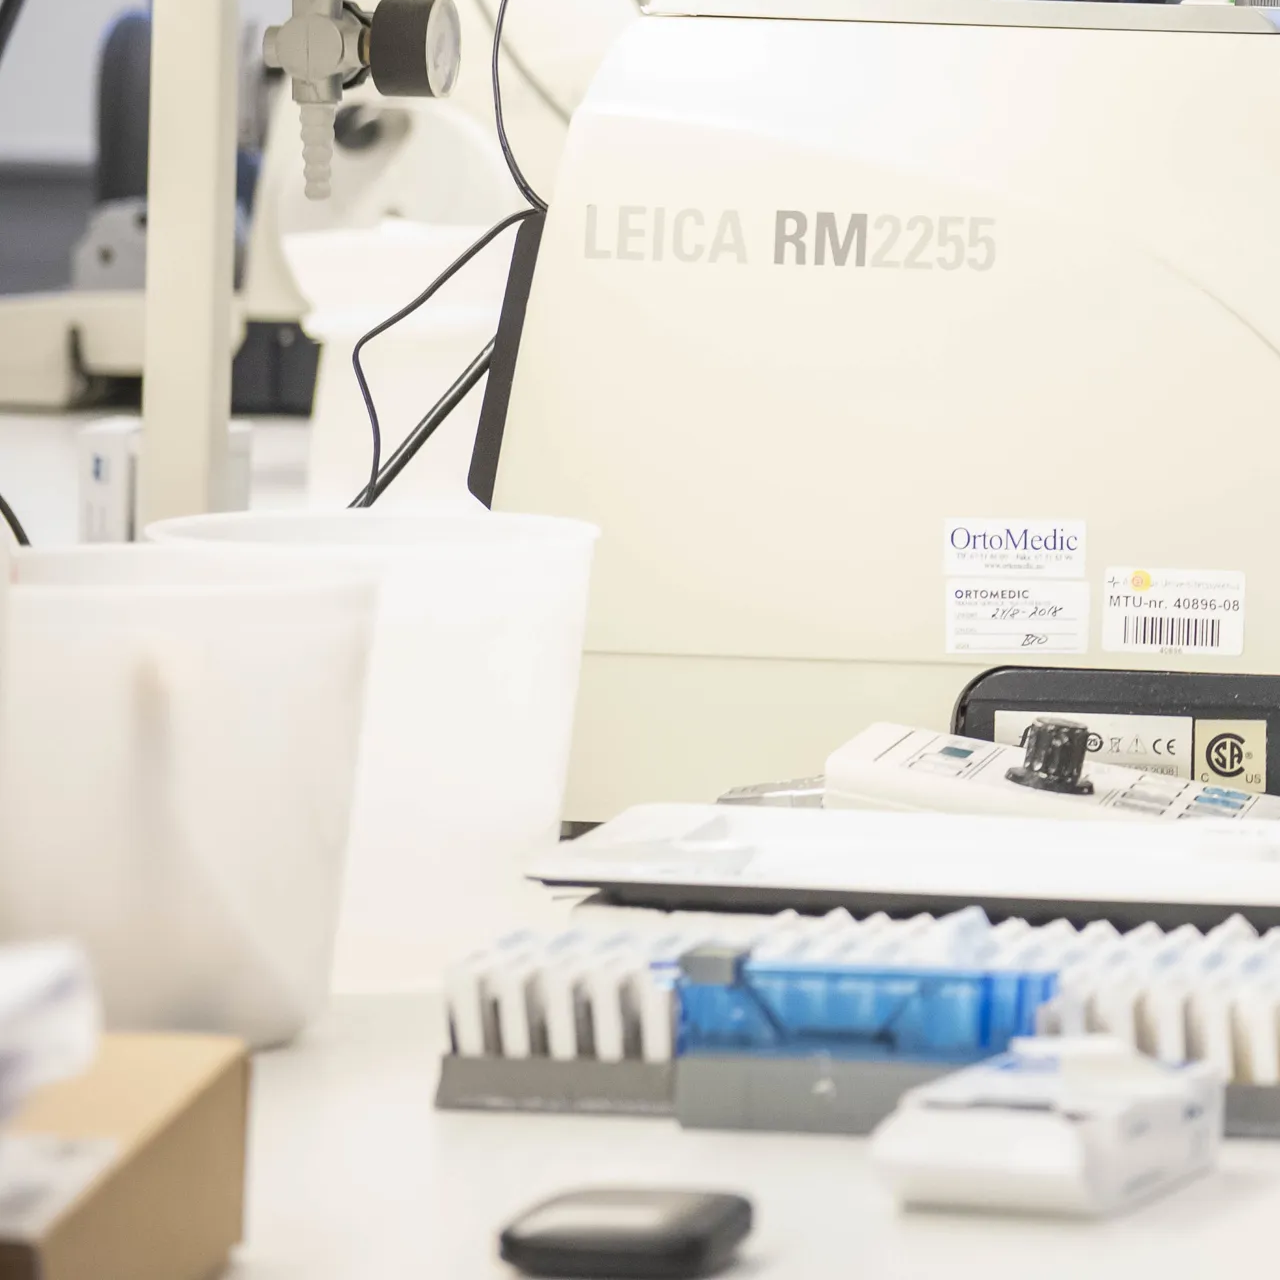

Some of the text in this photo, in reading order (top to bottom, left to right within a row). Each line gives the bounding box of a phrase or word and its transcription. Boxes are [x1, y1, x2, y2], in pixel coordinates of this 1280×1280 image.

[584, 204, 997, 272] LEICA RM2255
[951, 527, 1078, 551] OrtoMedic
[954, 589, 1030, 599] ORTOMEDIC
[1109, 595, 1240, 612] MTU-nr. 40896-08
[1245, 773, 1262, 784] US
